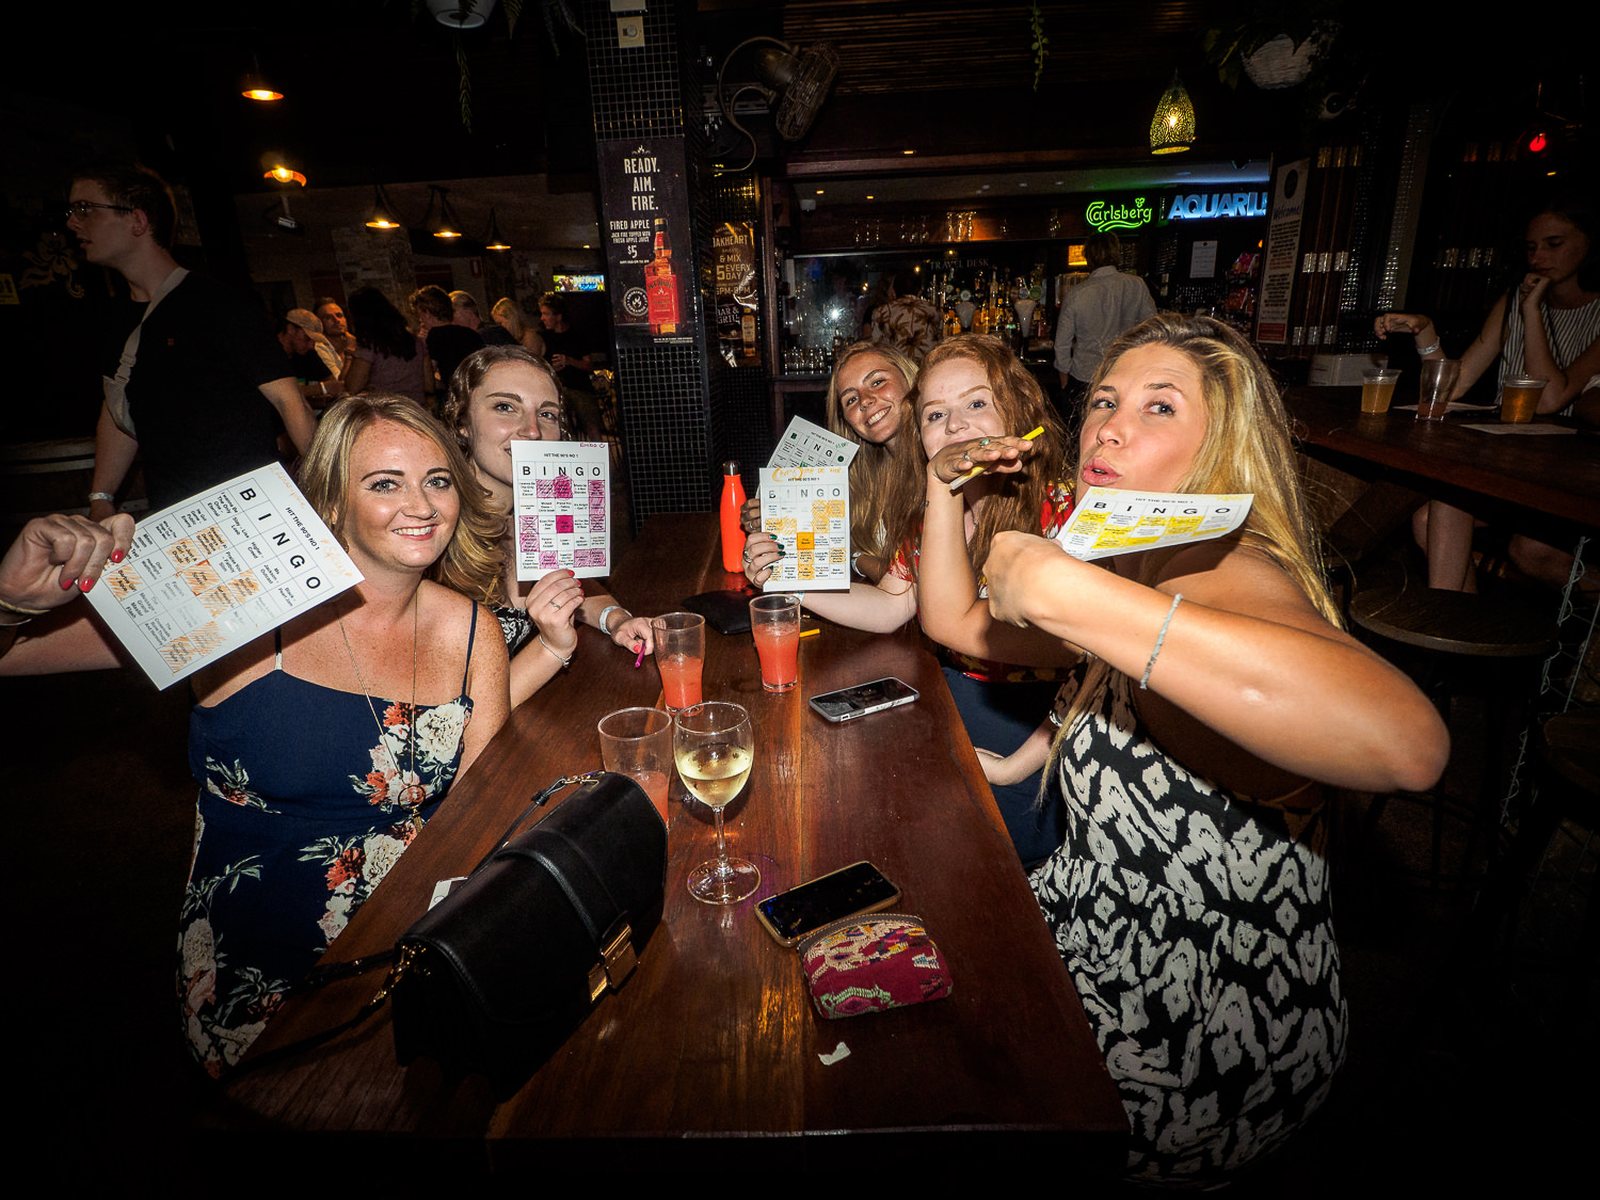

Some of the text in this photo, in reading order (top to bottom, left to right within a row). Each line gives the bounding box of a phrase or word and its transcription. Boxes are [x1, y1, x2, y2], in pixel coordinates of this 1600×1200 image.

[624, 157, 660, 174] READY.
[633, 177, 656, 192] AIM.
[631, 195, 659, 211] FIRE.
[1086, 200, 1153, 229] Carlsberg
[609, 219, 650, 230] FIRED APPLE
[627, 244, 638, 259] $5
[727, 254, 742, 262] MIX
[725, 263, 751, 272] EVERY
[725, 272, 741, 280] DAY
[813, 443, 821, 451] N
[522, 466, 601, 476] B I N G O
[800, 489, 808, 497] N
[816, 488, 824, 497] G
[832, 488, 840, 497] O
[286, 507, 295, 516] HIT
[293, 516, 303, 527] THE
[309, 538, 317, 546] NO
[239, 488, 321, 589] B I N G O
